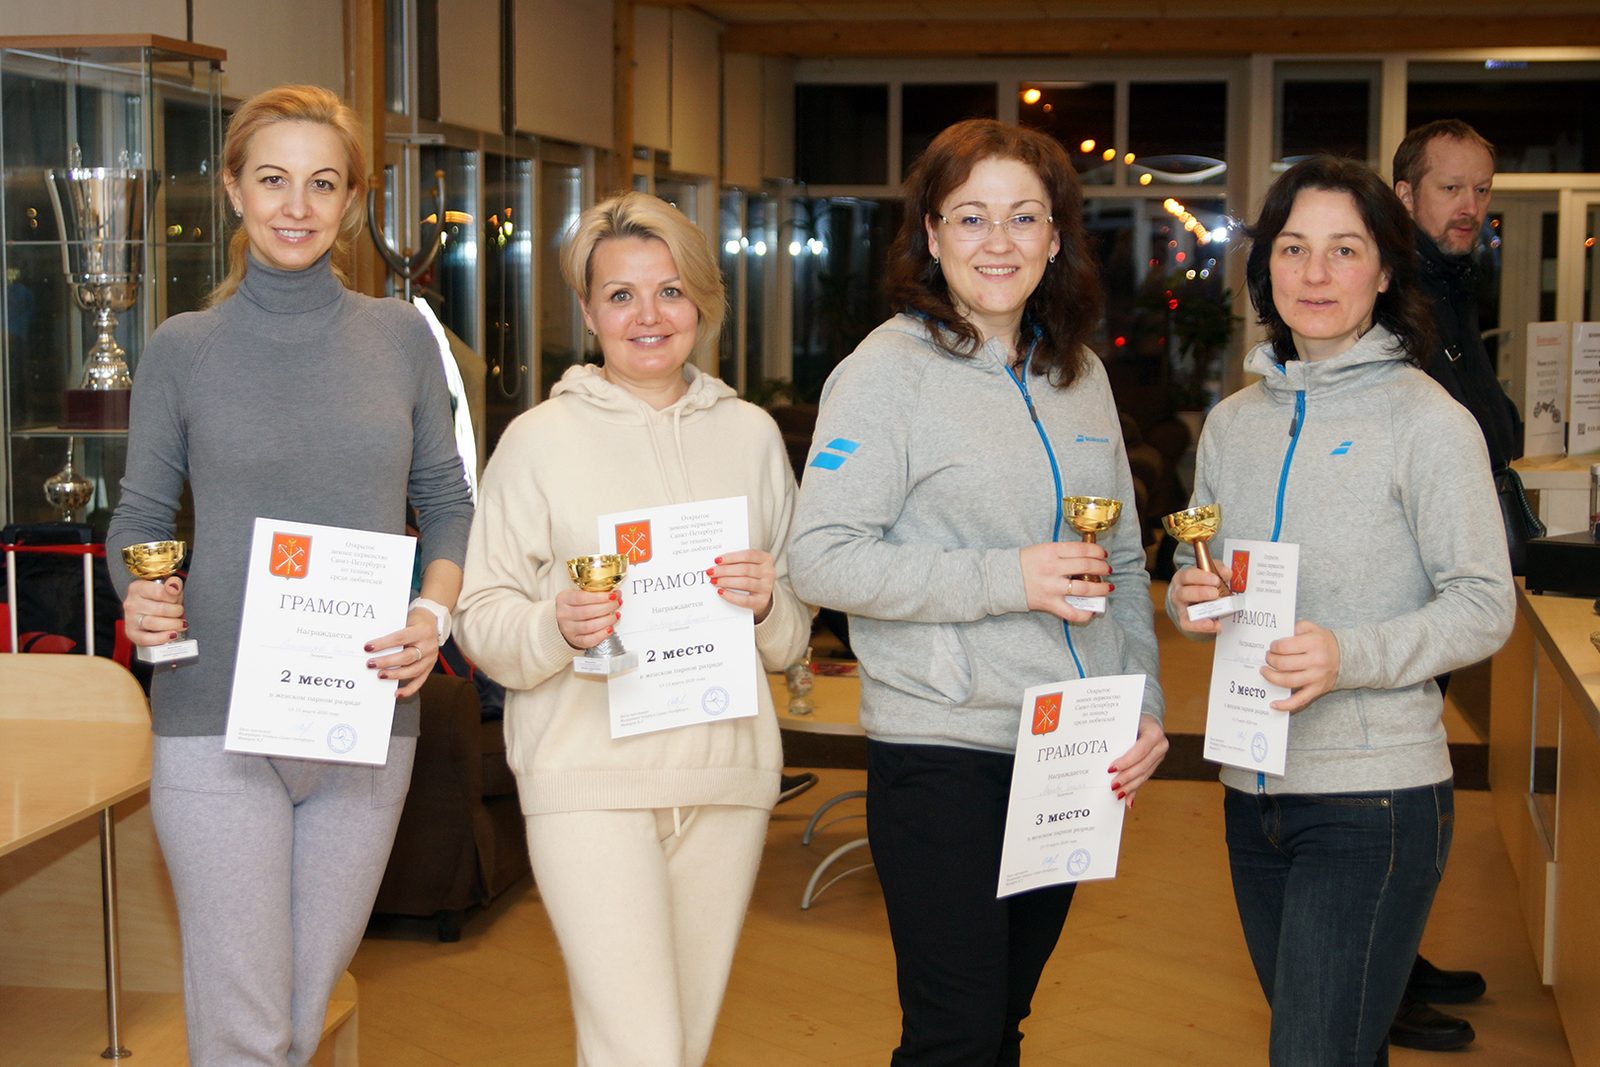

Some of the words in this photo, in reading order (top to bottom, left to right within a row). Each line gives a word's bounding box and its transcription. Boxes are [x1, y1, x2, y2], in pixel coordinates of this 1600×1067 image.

[632, 570, 712, 595] ГРАМОТ
[280, 593, 376, 619] ГРАМОТА
[652, 601, 704, 614] Награждается
[296, 627, 353, 640] Награждается
[646, 650, 656, 663] 2
[662, 643, 714, 660] место
[280, 669, 292, 683] 2
[298, 674, 355, 690] место
[1229, 680, 1236, 694] 3
[1237, 684, 1266, 699] место
[1036, 740, 1108, 763] ГРАМОТА
[1035, 813, 1044, 826] 3
[1047, 808, 1091, 823] место
